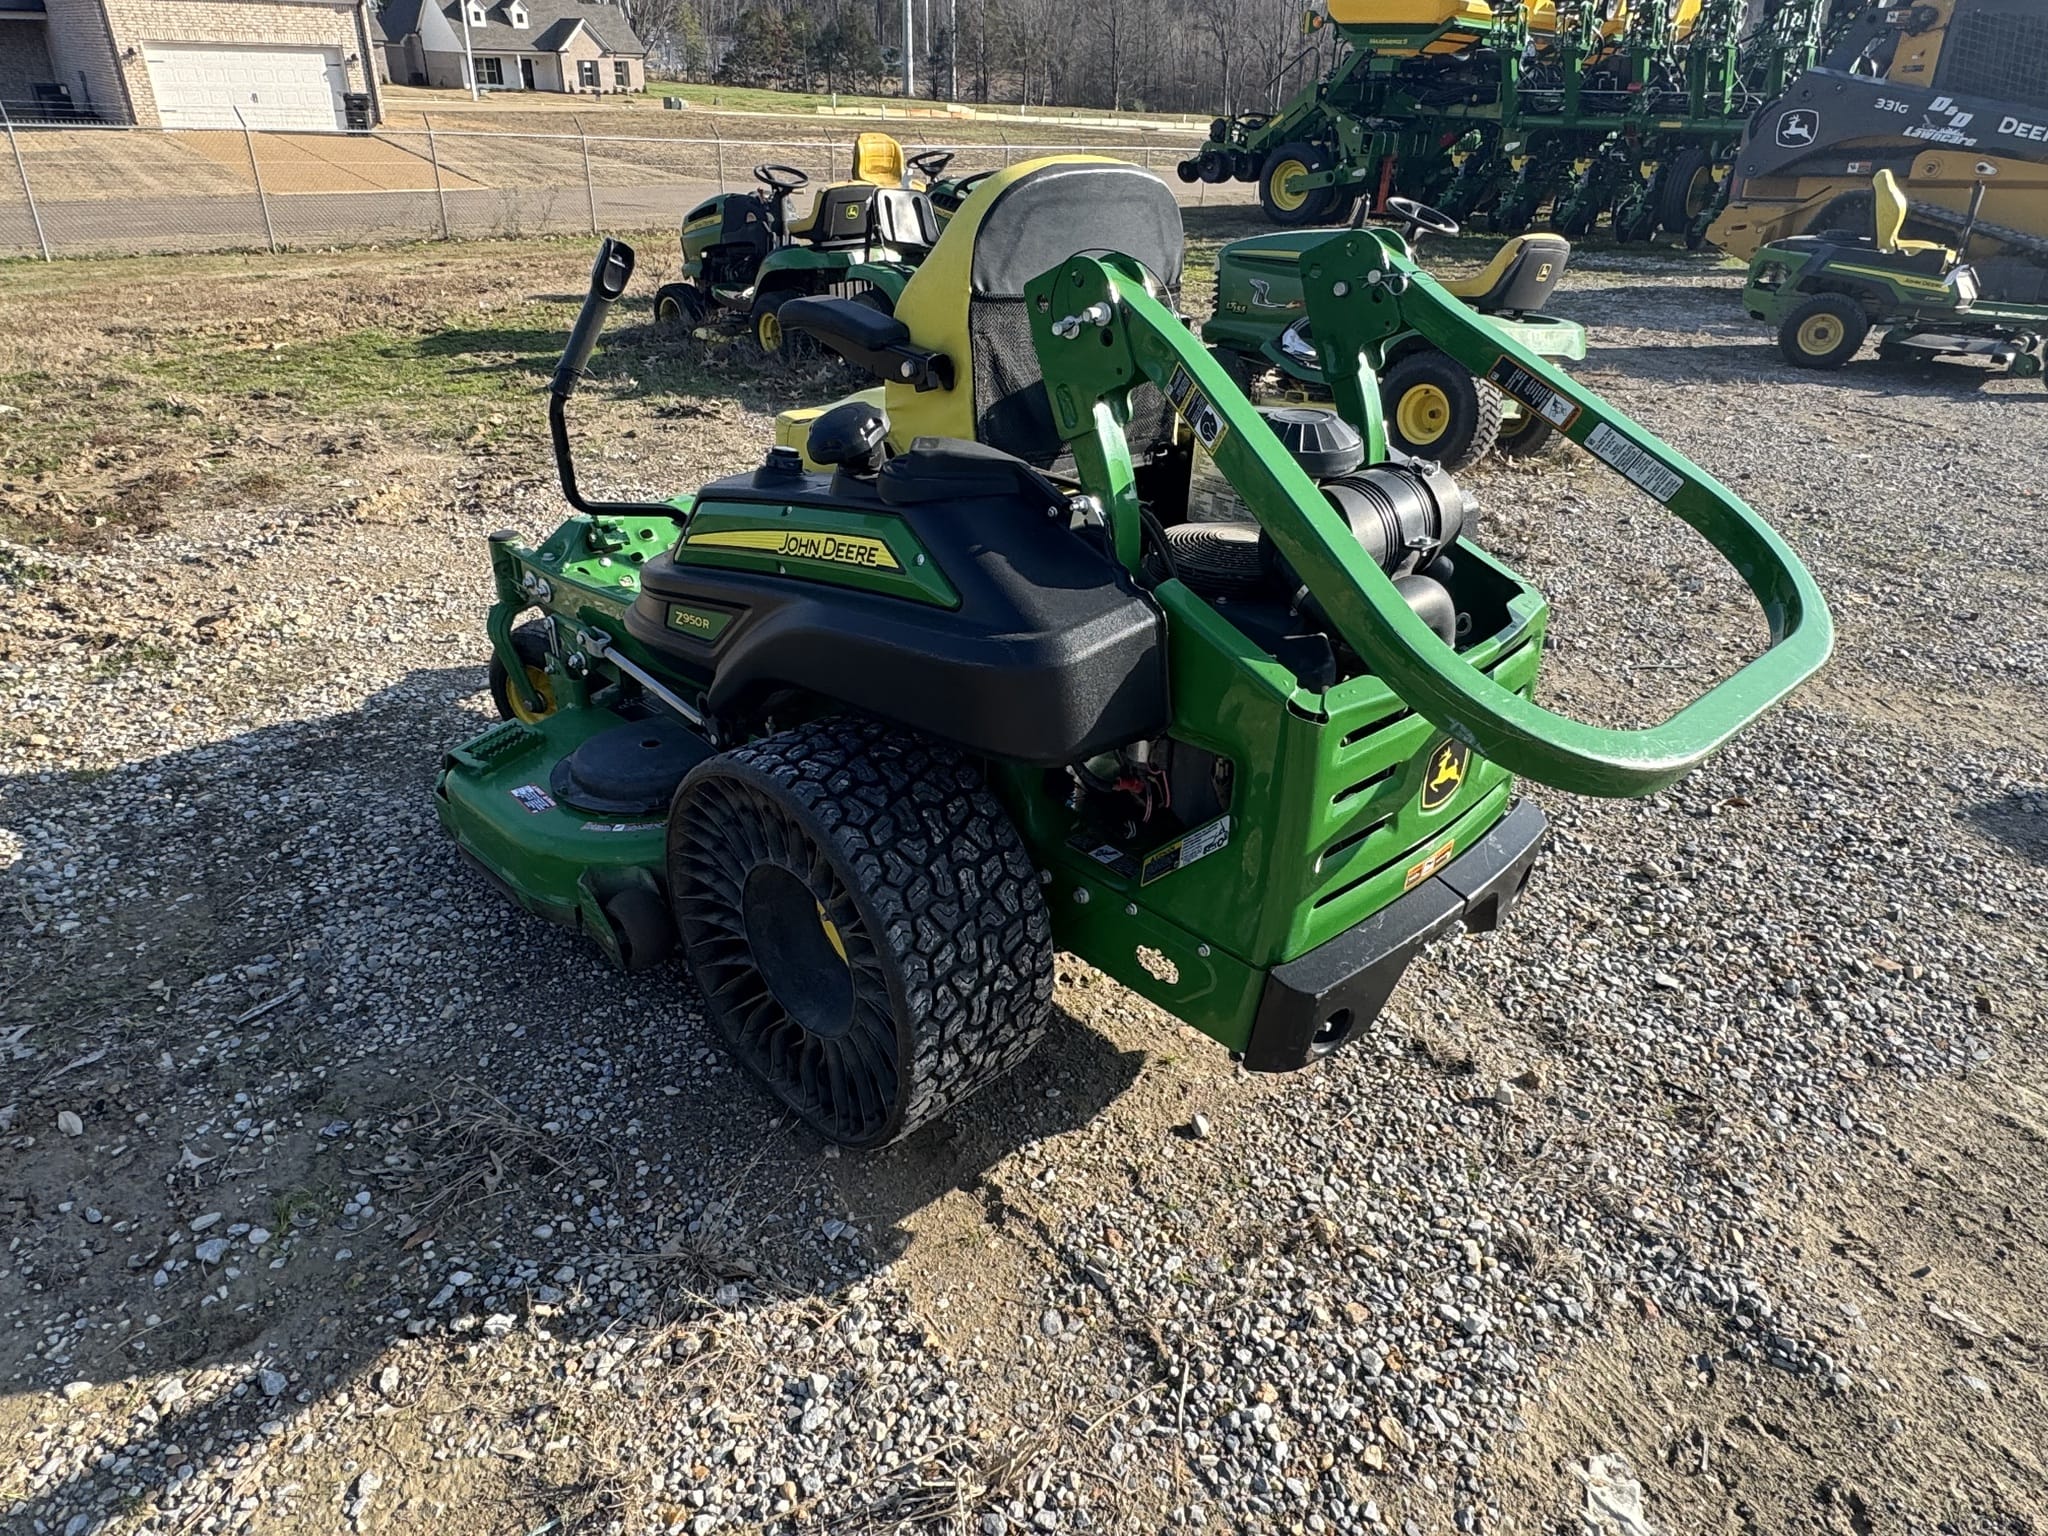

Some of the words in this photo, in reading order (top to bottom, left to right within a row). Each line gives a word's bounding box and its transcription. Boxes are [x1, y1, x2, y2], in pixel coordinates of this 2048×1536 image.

[1874, 98, 1909, 114] 331G
[779, 532, 821, 556] JOHN
[823, 538, 878, 565] DEERE
[674, 611, 710, 630] Z950R
